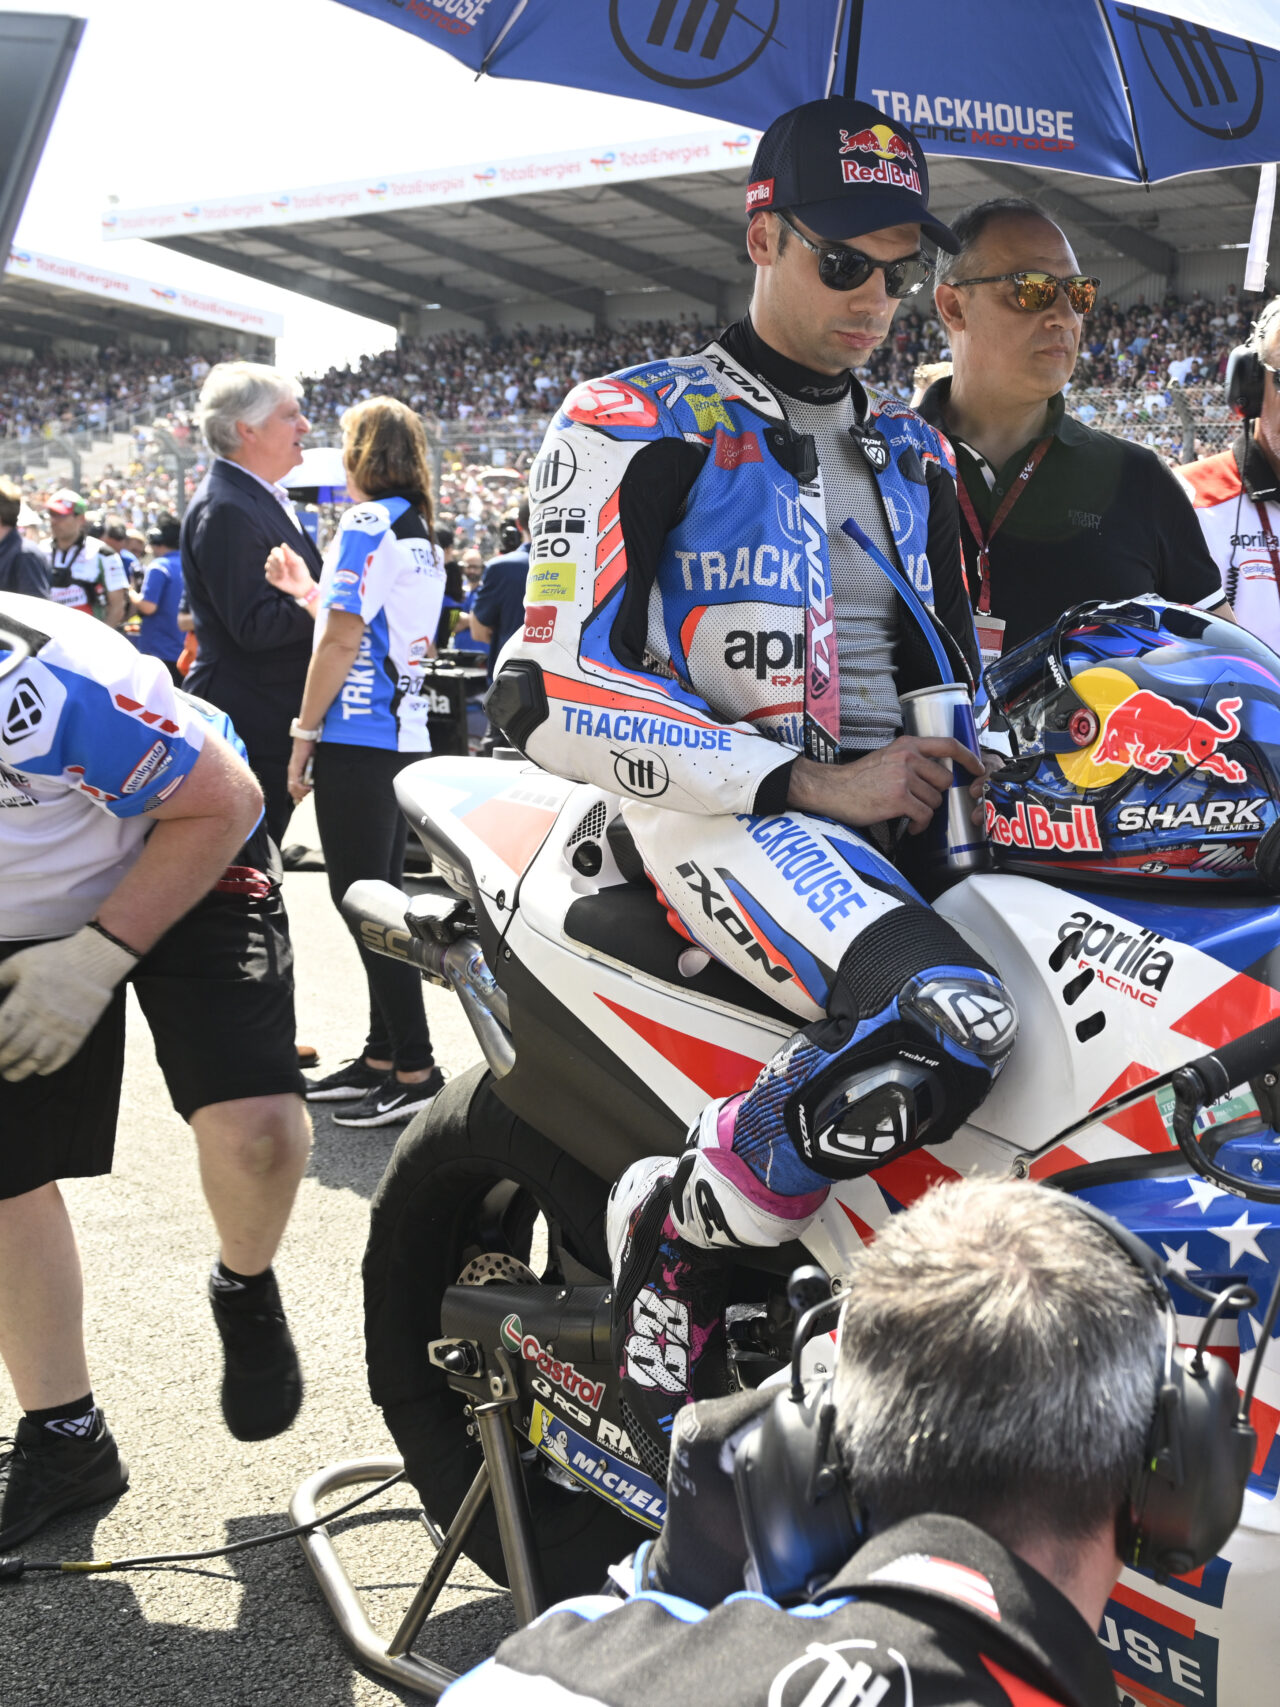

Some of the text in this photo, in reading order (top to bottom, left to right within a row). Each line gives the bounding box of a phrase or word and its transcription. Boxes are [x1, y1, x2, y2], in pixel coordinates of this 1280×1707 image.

[871, 89, 1075, 141] TRACKHOUSE
[499, 160, 581, 183] TotalEnergies
[619, 144, 711, 169] TotalEnergies
[841, 160, 922, 195] Red Bull
[1047, 654, 1066, 690] SHARK
[562, 705, 732, 751] TRACKHOUSE
[127, 745, 164, 792] sterilgarda
[984, 800, 1103, 852] Red Bull
[1117, 798, 1269, 832] SHARK
[1208, 822, 1261, 833] HELMETS
[1057, 911, 1175, 993] aprilia
[521, 1334, 606, 1411] Castrol
[553, 1391, 592, 1427] RCB
[623, 1451, 641, 1466] CHAIN
[572, 1450, 668, 1520] MICHEL
